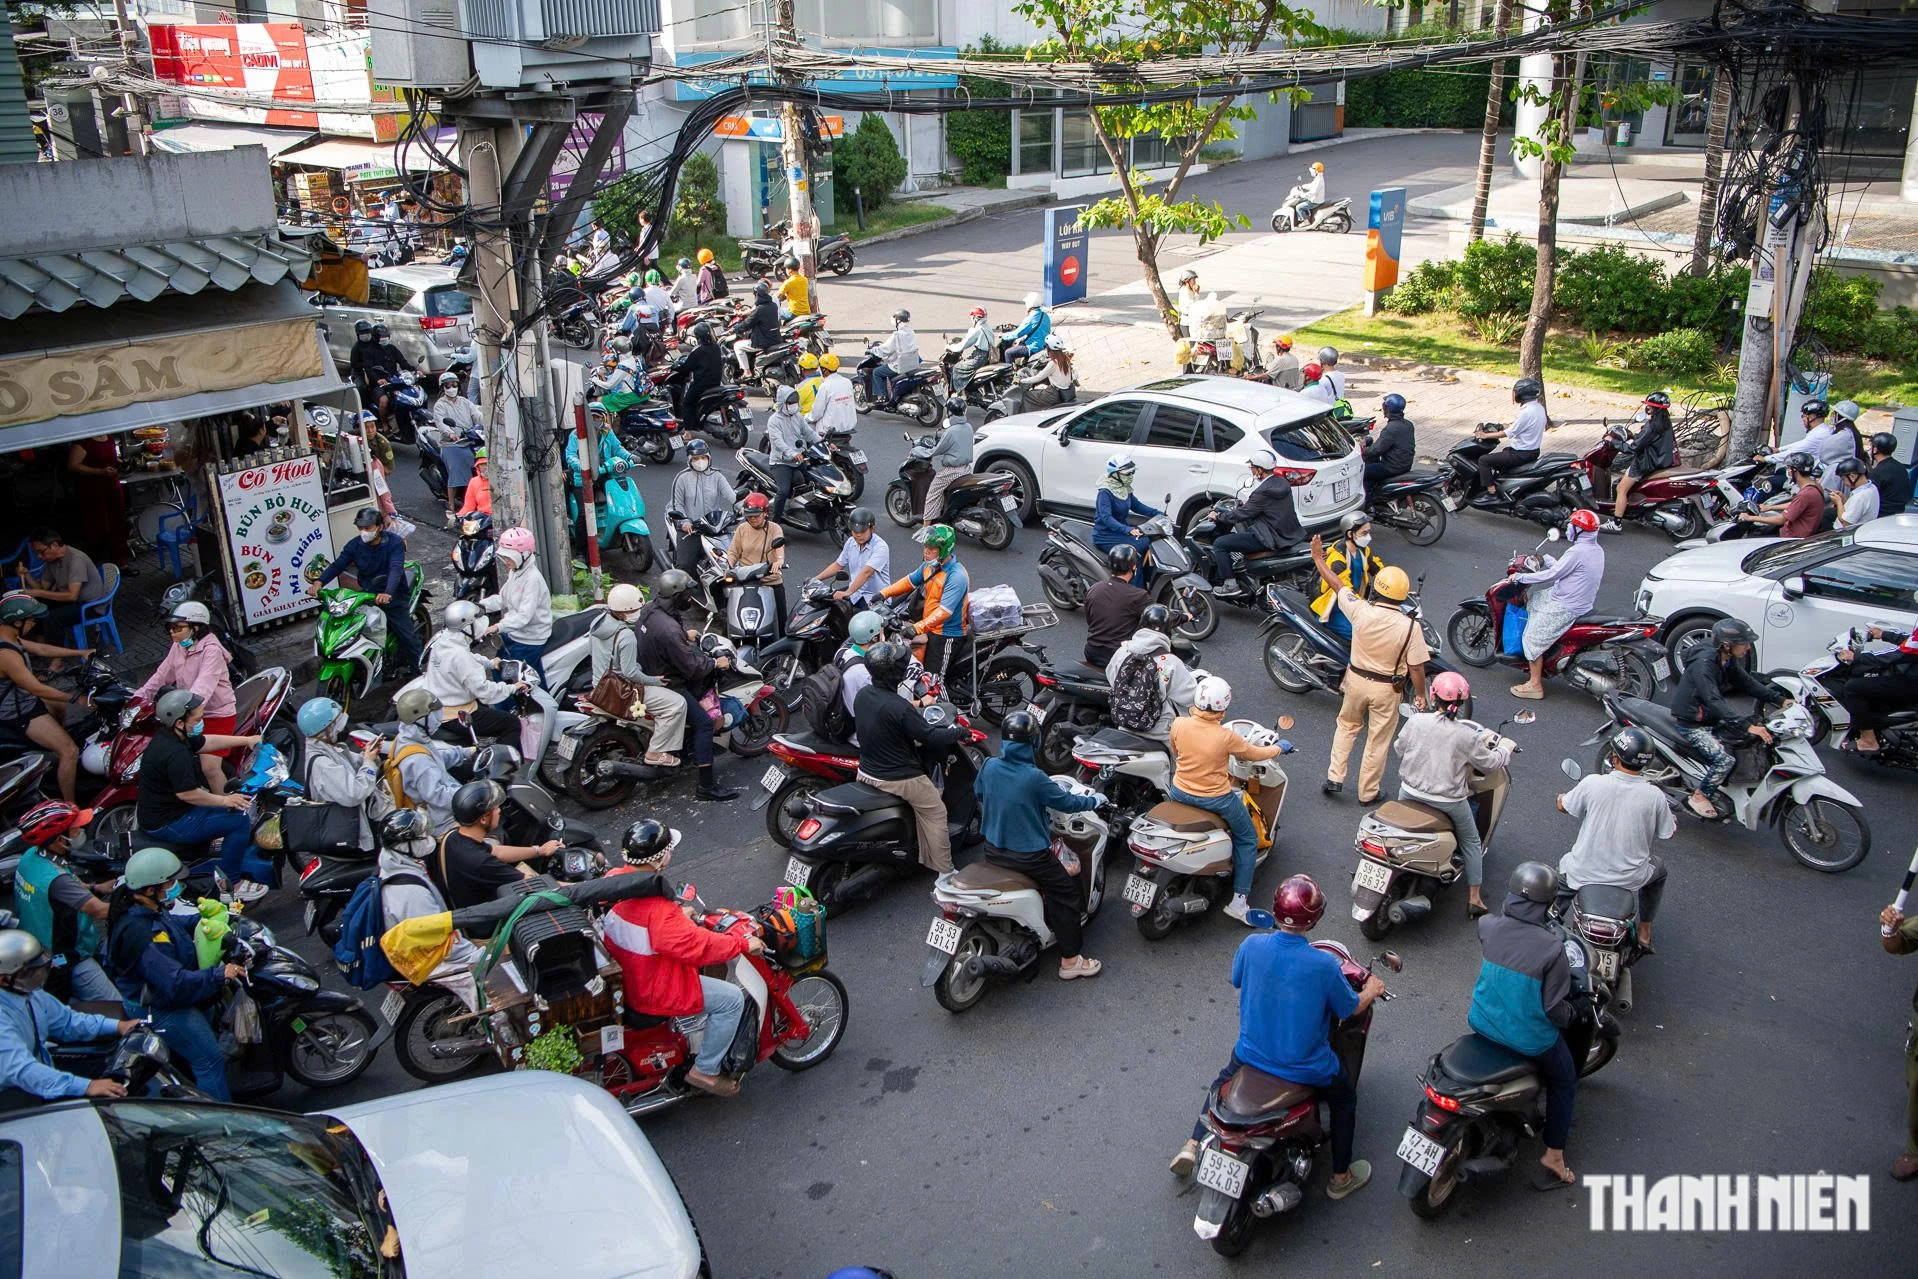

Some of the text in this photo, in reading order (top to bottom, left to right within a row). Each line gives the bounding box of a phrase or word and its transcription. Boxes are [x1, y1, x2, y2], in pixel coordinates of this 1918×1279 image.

[52, 107, 64, 116] 38
[1383, 211, 1395, 222] VIB
[1061, 240, 1081, 250] WAY OUT
[48, 354, 184, 406] SÂM
[238, 468, 267, 490] Cô
[271, 459, 315, 484] Hoà
[236, 505, 262, 538] BÚN
[264, 493, 286, 511] BÒ
[241, 544, 274, 564] BÚN
[1362, 862, 1387, 880] 59-S3
[1130, 877, 1152, 894] 59-S1
[935, 921, 957, 939] 59-S3
[1209, 1153, 1241, 1179] 59-S2
[1398, 1144, 1437, 1175] 047.12
[1200, 1167, 1241, 1195] 324.03
